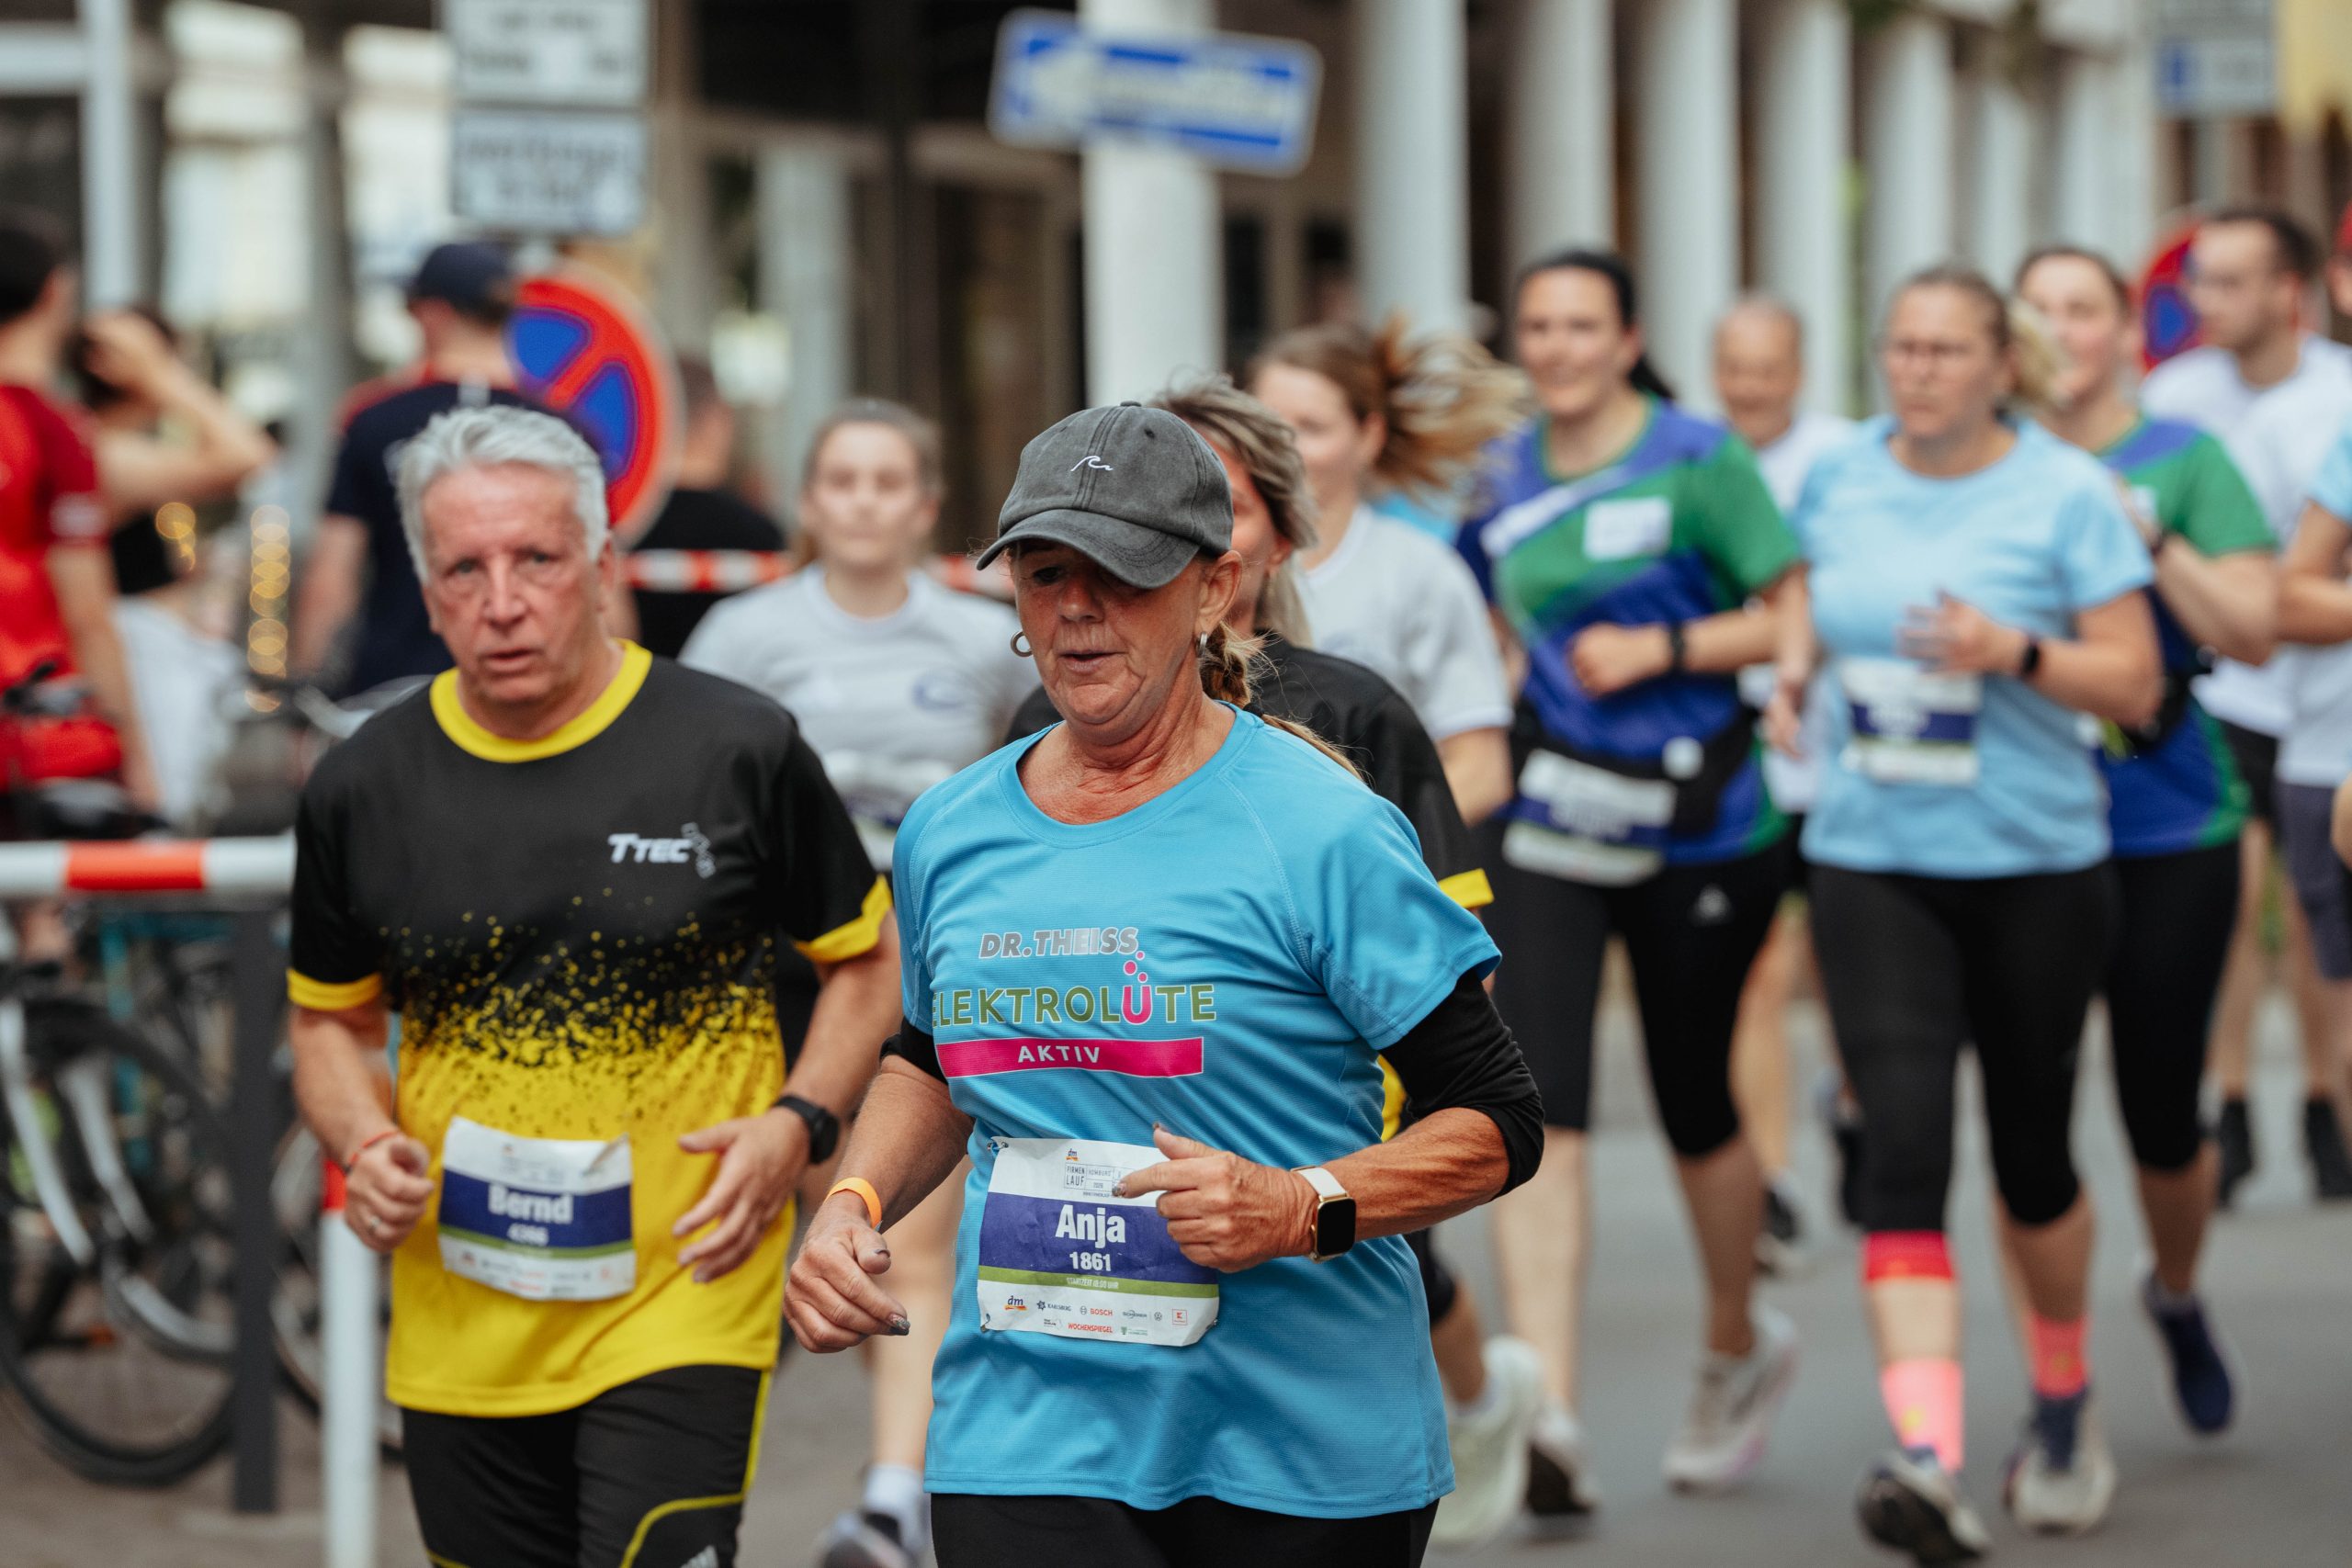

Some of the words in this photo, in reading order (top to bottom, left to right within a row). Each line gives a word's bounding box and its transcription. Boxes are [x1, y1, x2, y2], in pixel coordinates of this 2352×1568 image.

[978, 927, 1138, 959] DR.THEISS
[933, 960, 1216, 1028] LEKTROLÜTE
[1018, 1045, 1100, 1063] AKTIV
[1067, 1166, 1085, 1174] FIRMEN
[1066, 1175, 1085, 1187] LAUF
[488, 1183, 573, 1224] Bernd
[1055, 1204, 1126, 1249] Anja
[1069, 1251, 1112, 1272] 1861
[1007, 1295, 1023, 1306] dm
[1090, 1308, 1114, 1316] BOSCH
[1068, 1323, 1114, 1334] WOCHENSPIEGEL
